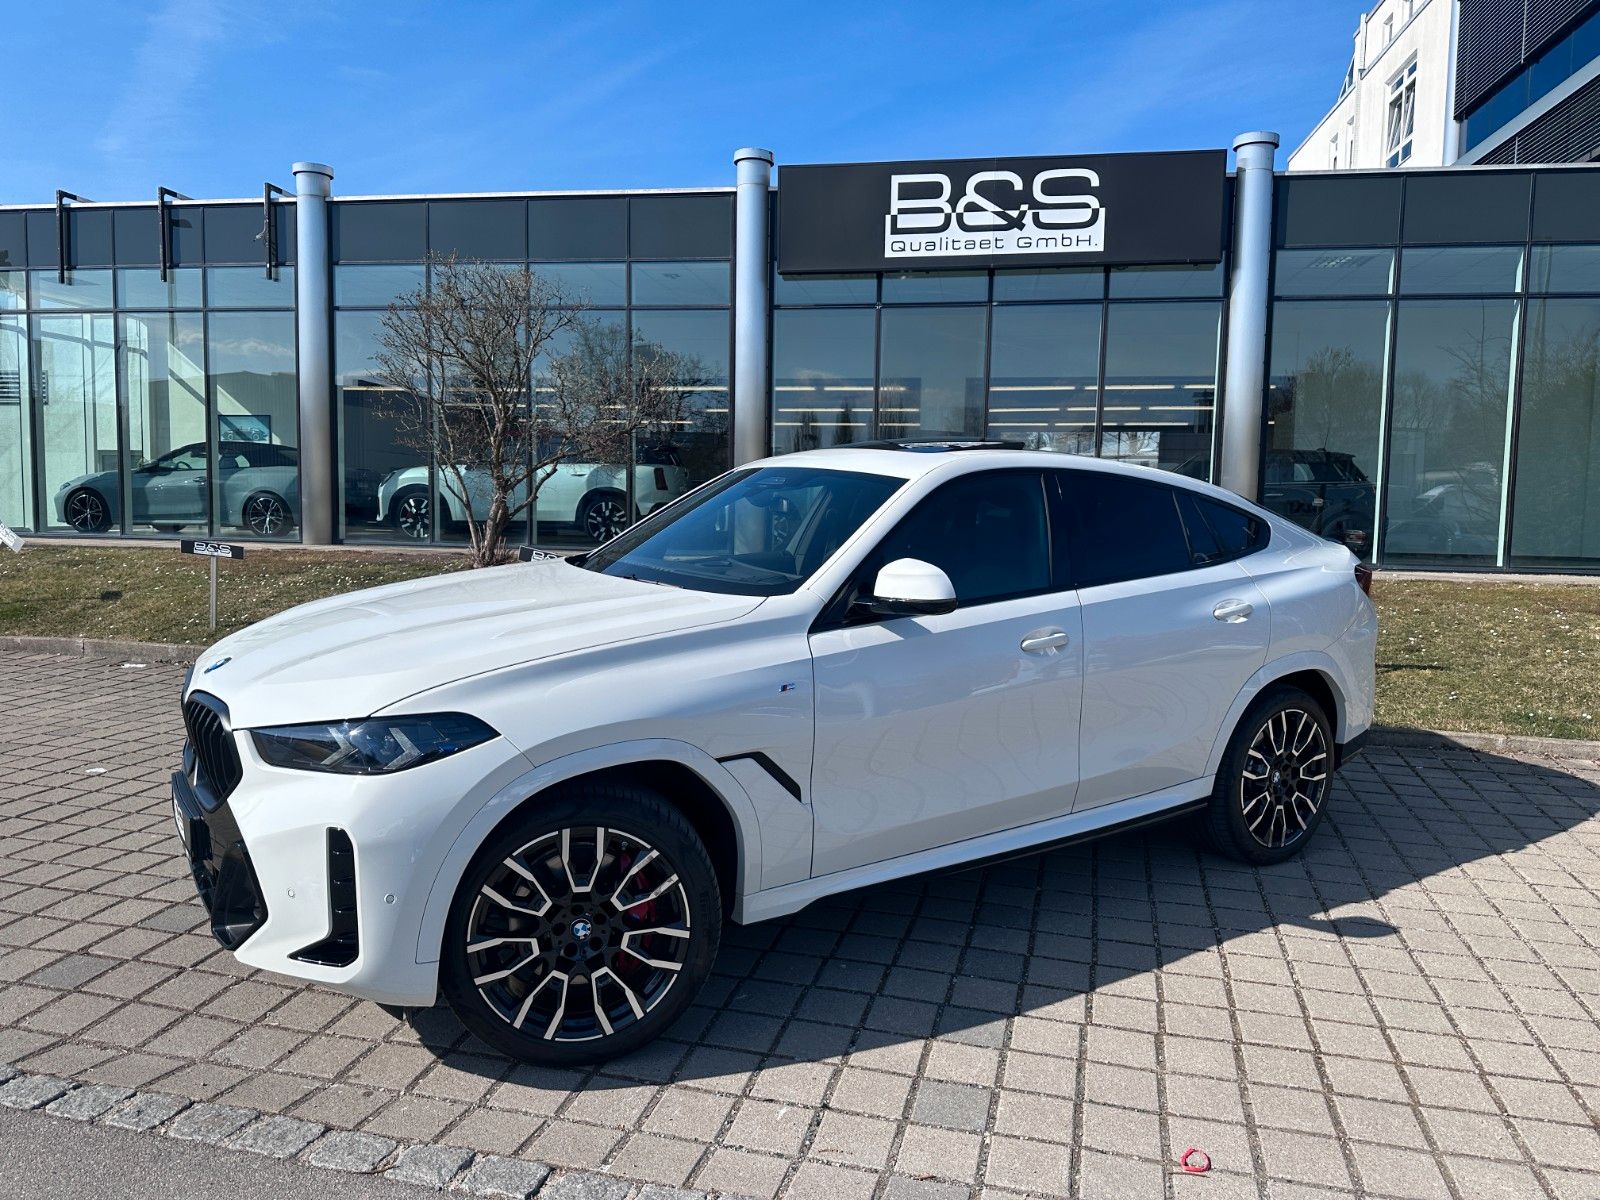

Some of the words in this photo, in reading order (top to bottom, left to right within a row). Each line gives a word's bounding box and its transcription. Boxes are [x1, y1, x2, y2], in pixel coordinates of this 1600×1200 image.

[890, 168, 1100, 235] B&S
[890, 237, 1004, 253] Qualitaet
[1016, 234, 1098, 248] GmbH.
[194, 542, 231, 555] B&S
